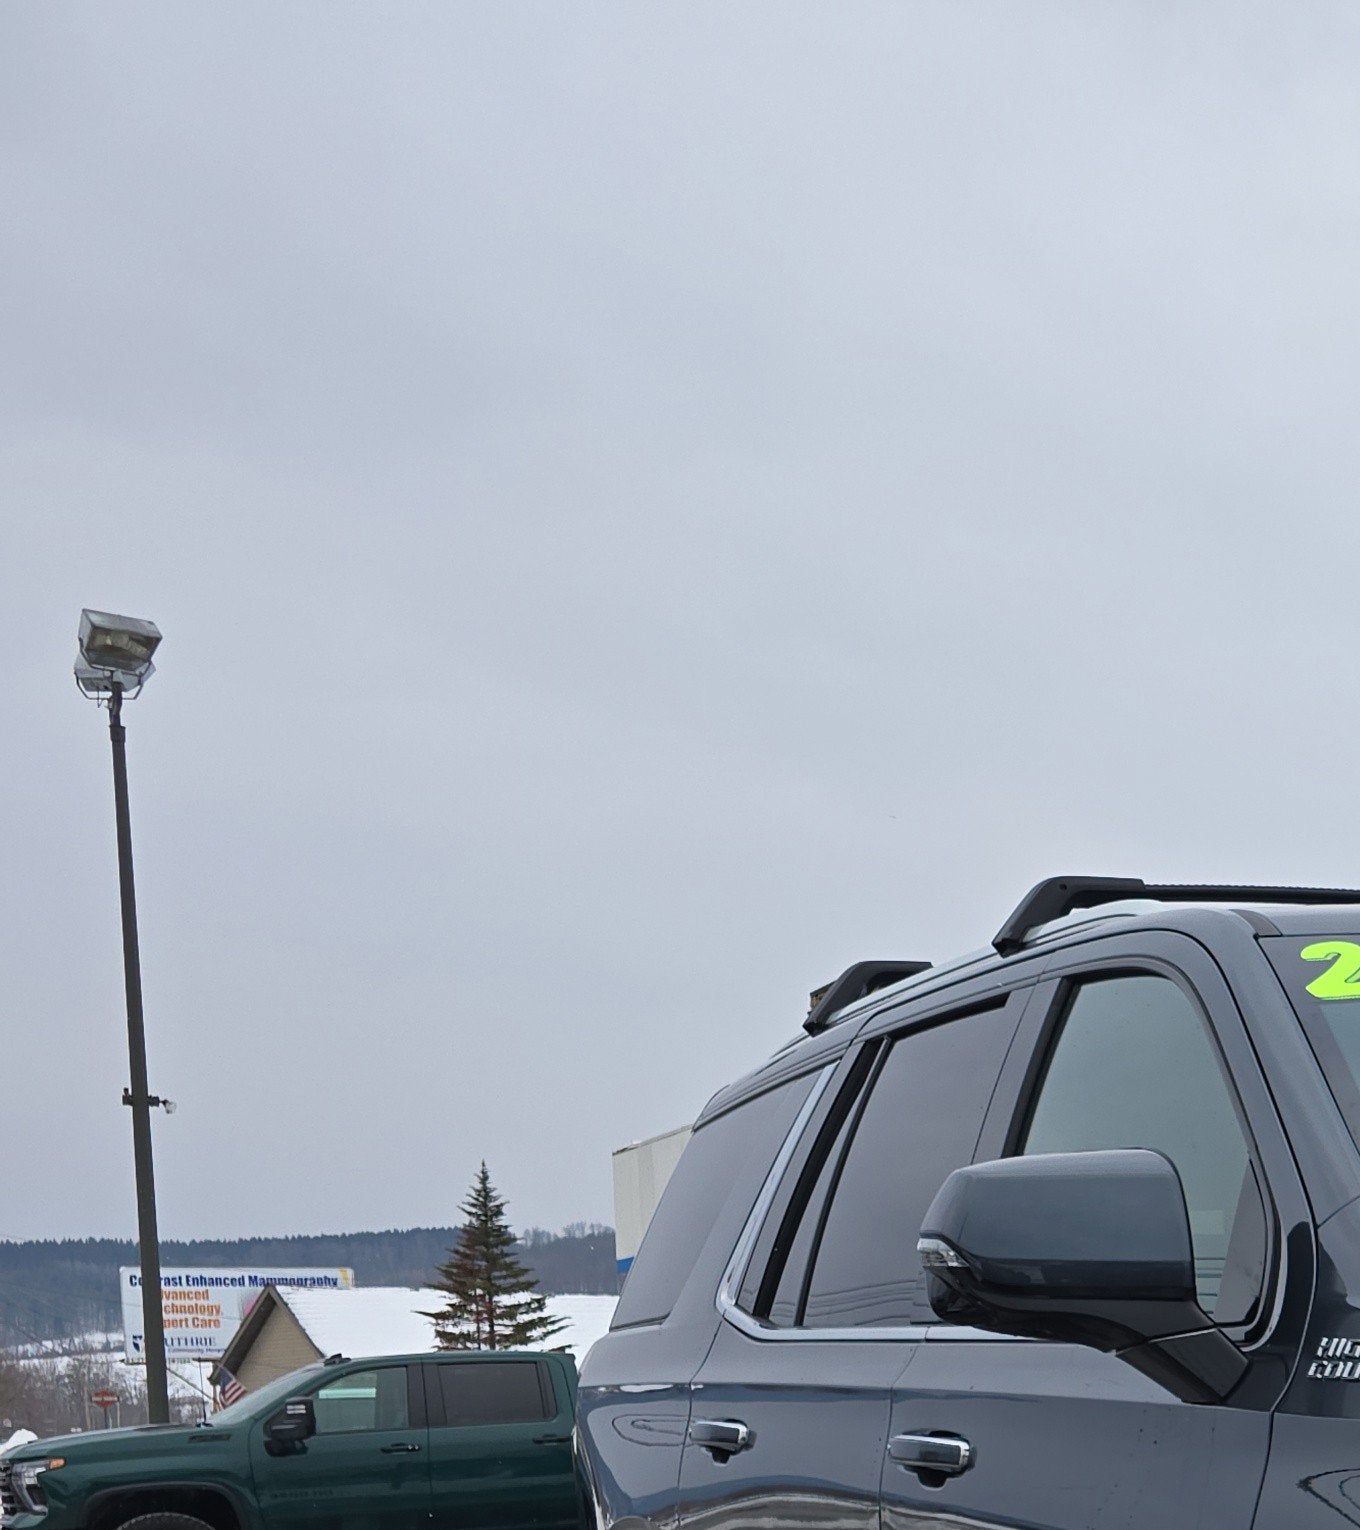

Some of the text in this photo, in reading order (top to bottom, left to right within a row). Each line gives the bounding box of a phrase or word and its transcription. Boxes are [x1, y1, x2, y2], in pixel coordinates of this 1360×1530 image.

[186, 1275, 245, 1287] Enhanced
[163, 1317, 221, 1330] pert Care
[164, 1336, 216, 1347] UTHRIE
